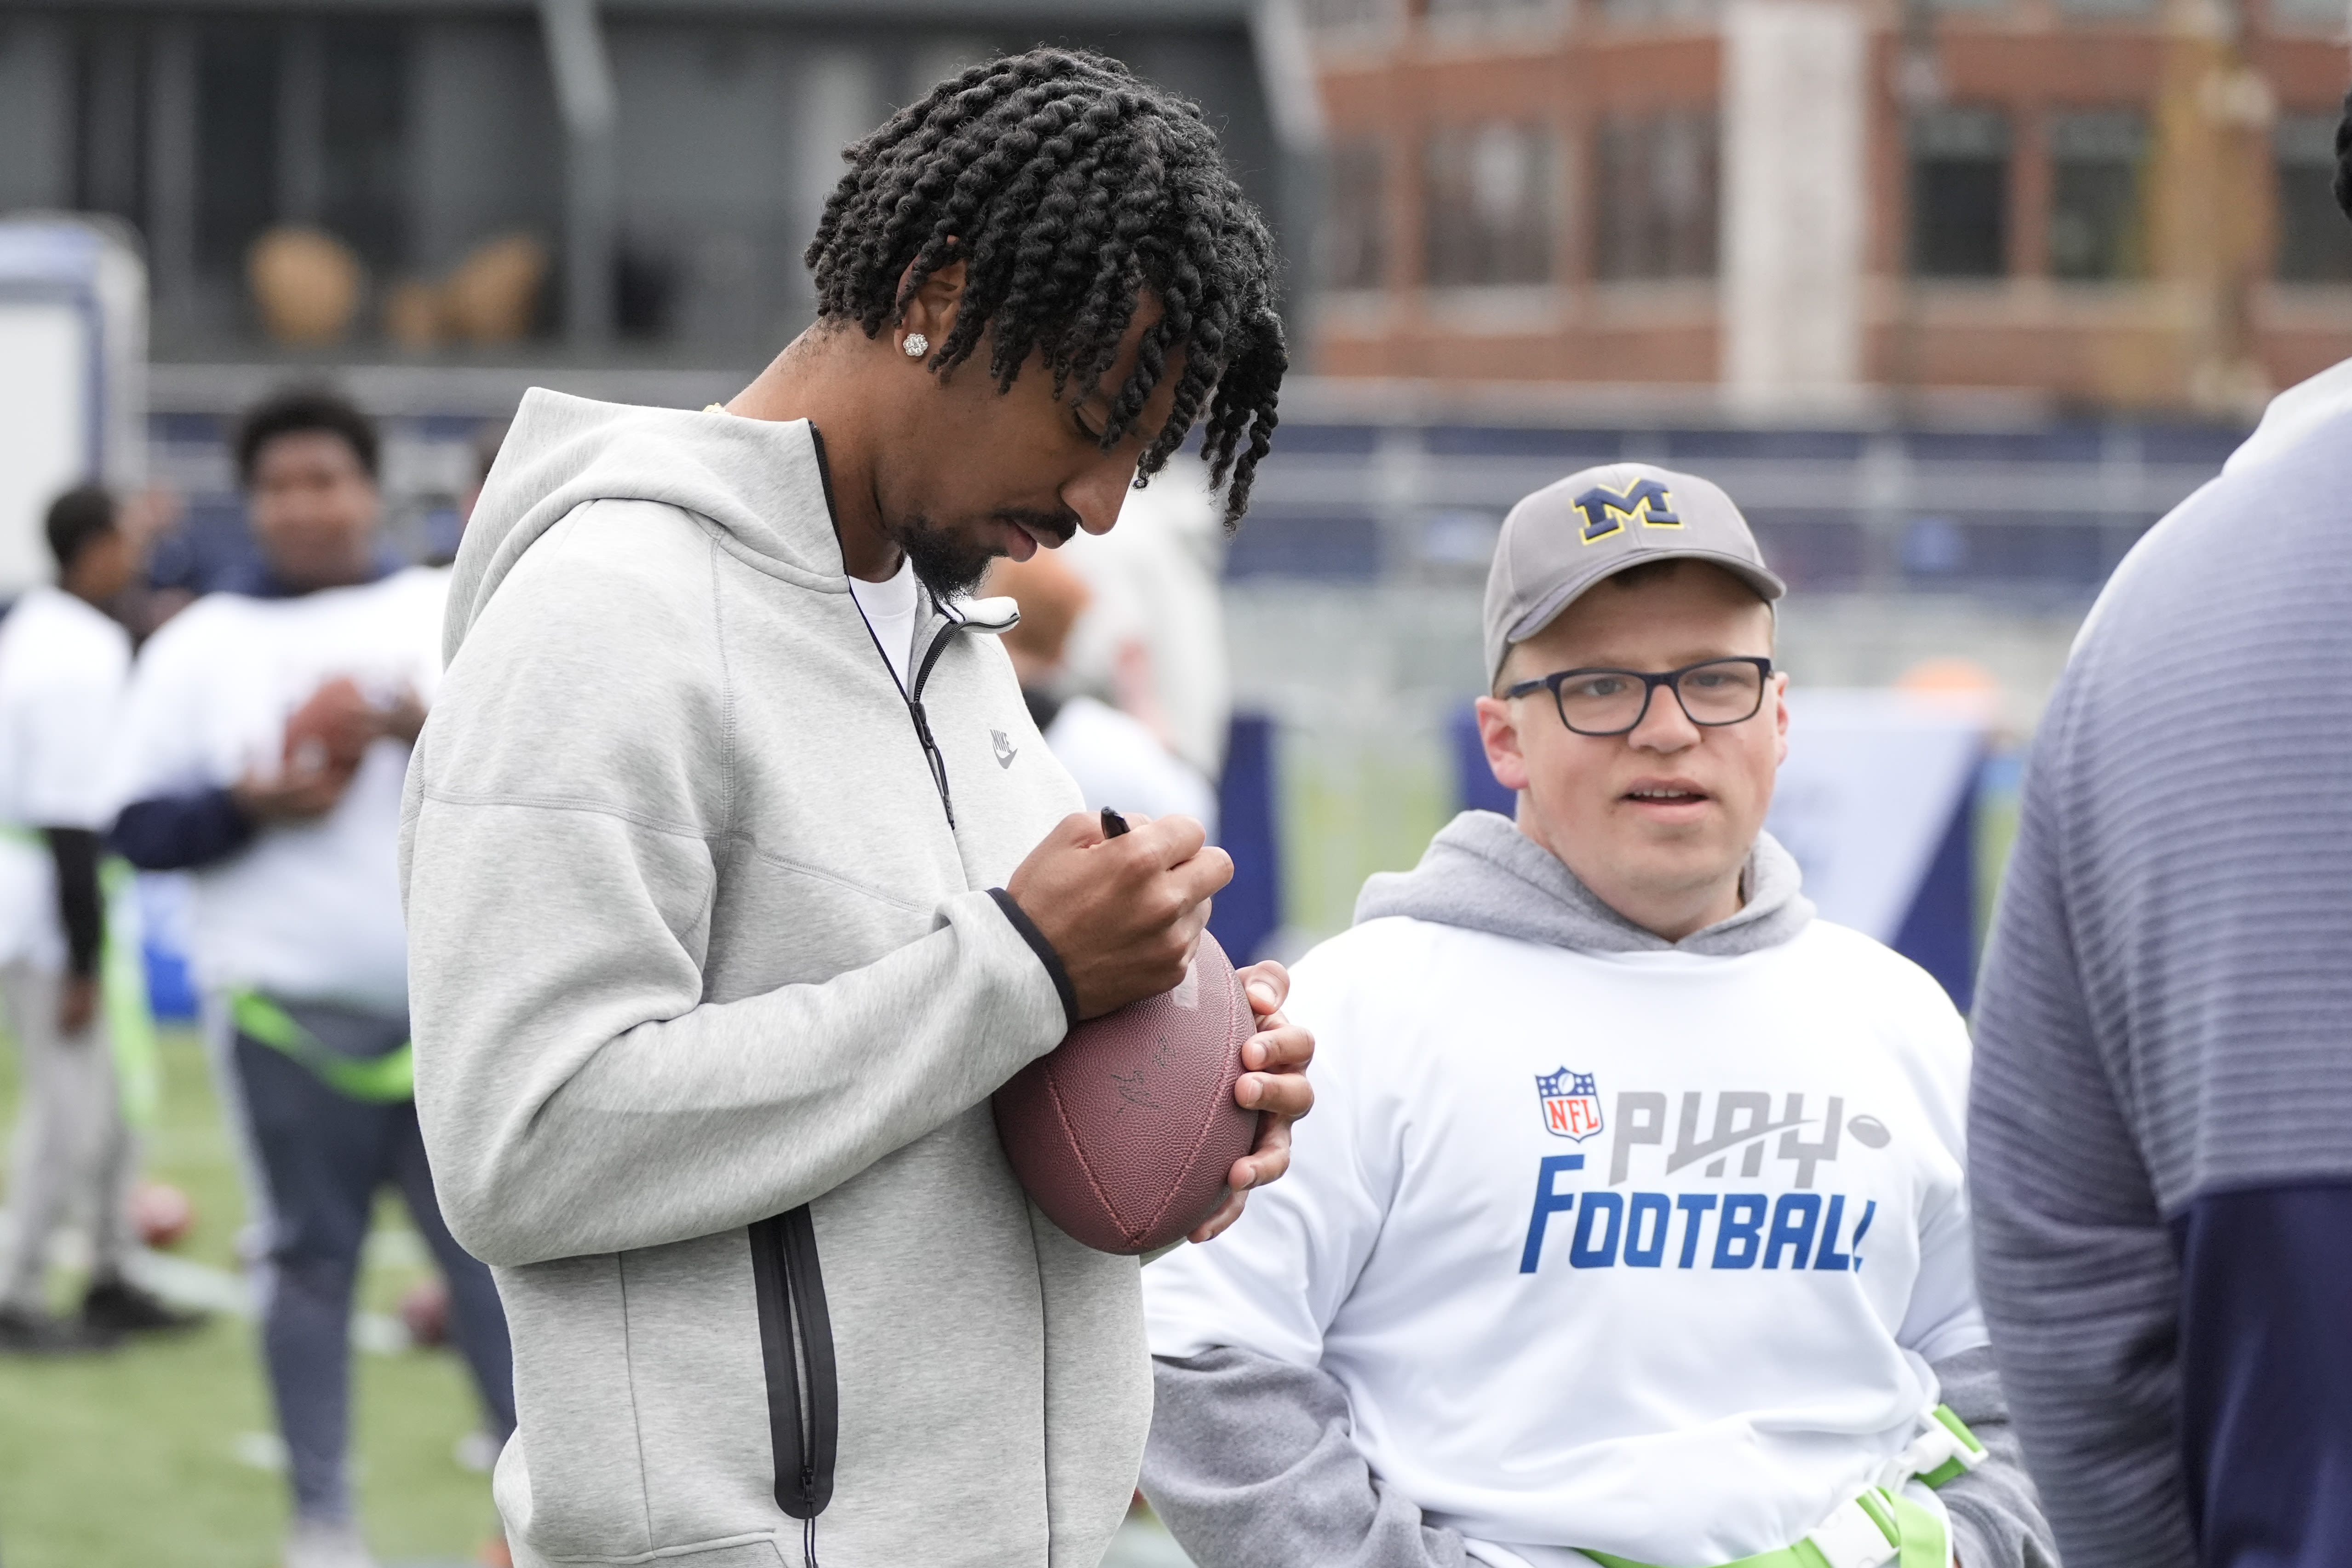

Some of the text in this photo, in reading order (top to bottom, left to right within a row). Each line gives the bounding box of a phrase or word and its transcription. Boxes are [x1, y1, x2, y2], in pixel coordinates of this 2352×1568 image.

[1571, 477, 1684, 546] M
[989, 729, 1012, 753] NIKE
[1547, 1098, 1599, 1134] NFL
[1609, 1091, 1844, 1189] PLAY
[1520, 1154, 1876, 1274] FOOTBALL
